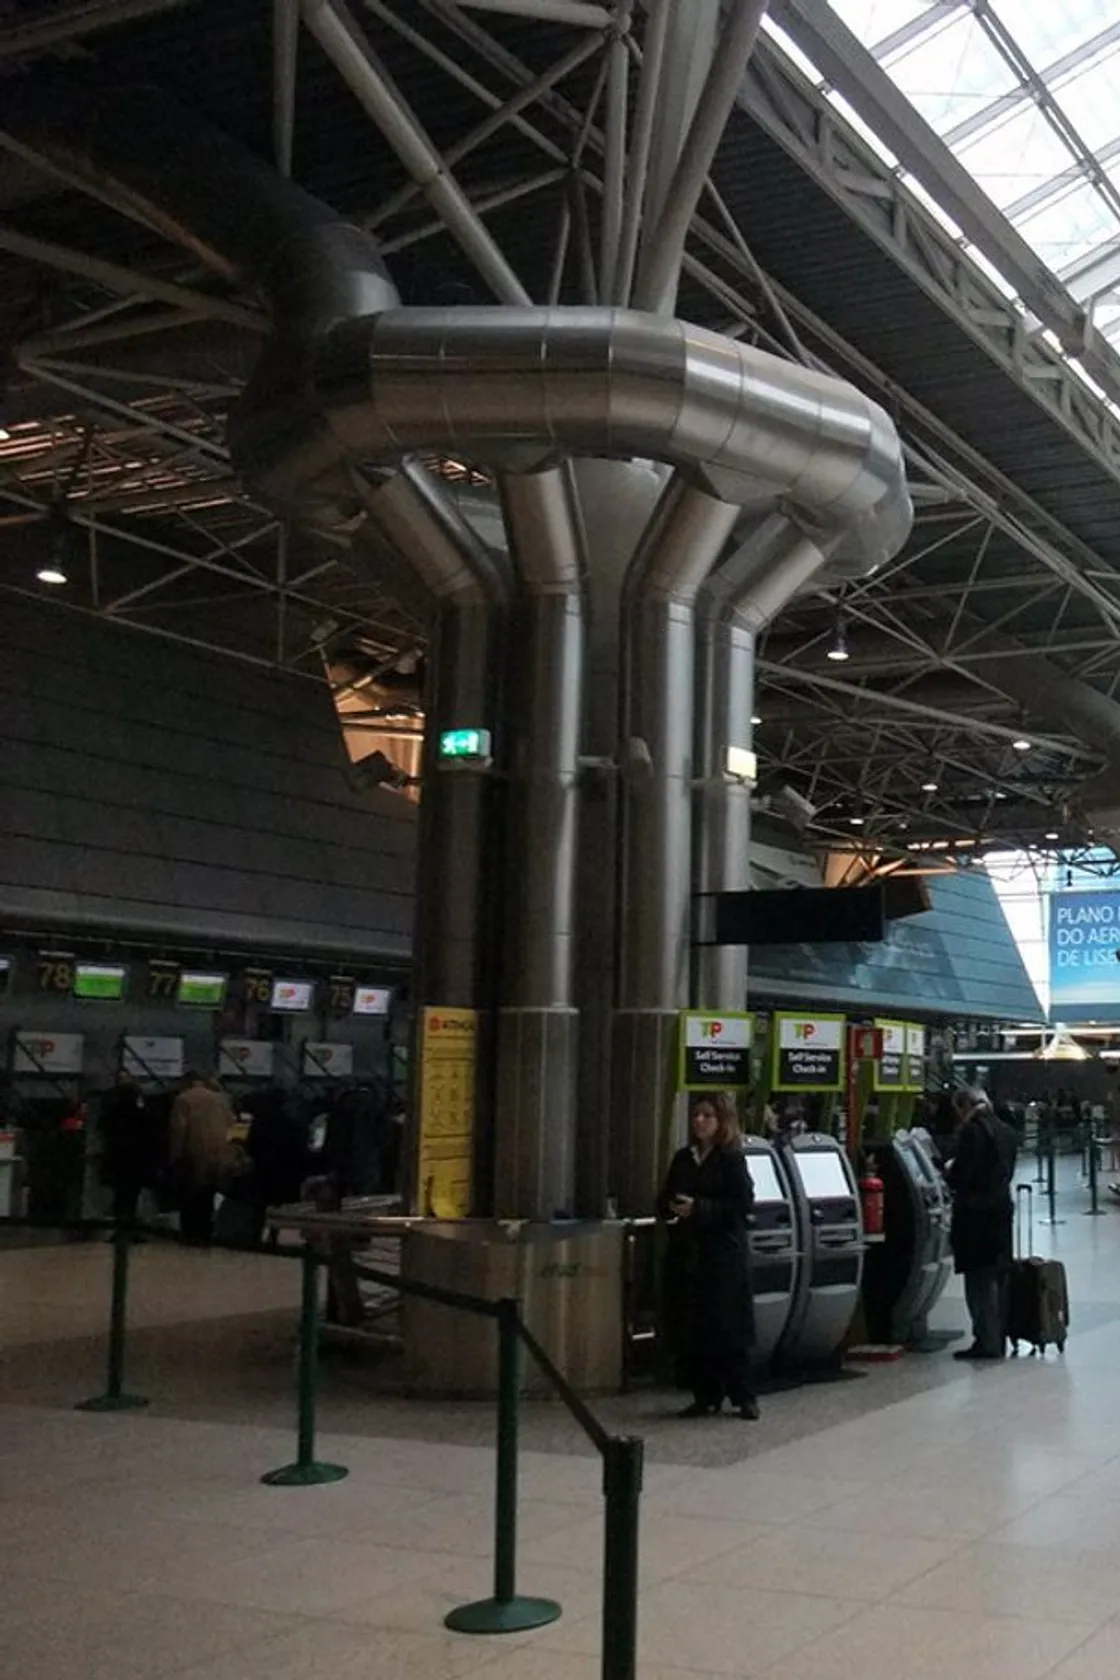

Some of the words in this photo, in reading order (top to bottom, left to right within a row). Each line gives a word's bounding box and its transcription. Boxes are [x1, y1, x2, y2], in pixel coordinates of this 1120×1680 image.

[1057, 906, 1114, 925] PLANO
[1057, 928, 1084, 945] DO
[1057, 948, 1081, 967] DE
[38, 961, 70, 990] 78
[150, 971, 177, 996] 77
[246, 977, 270, 1002] 76
